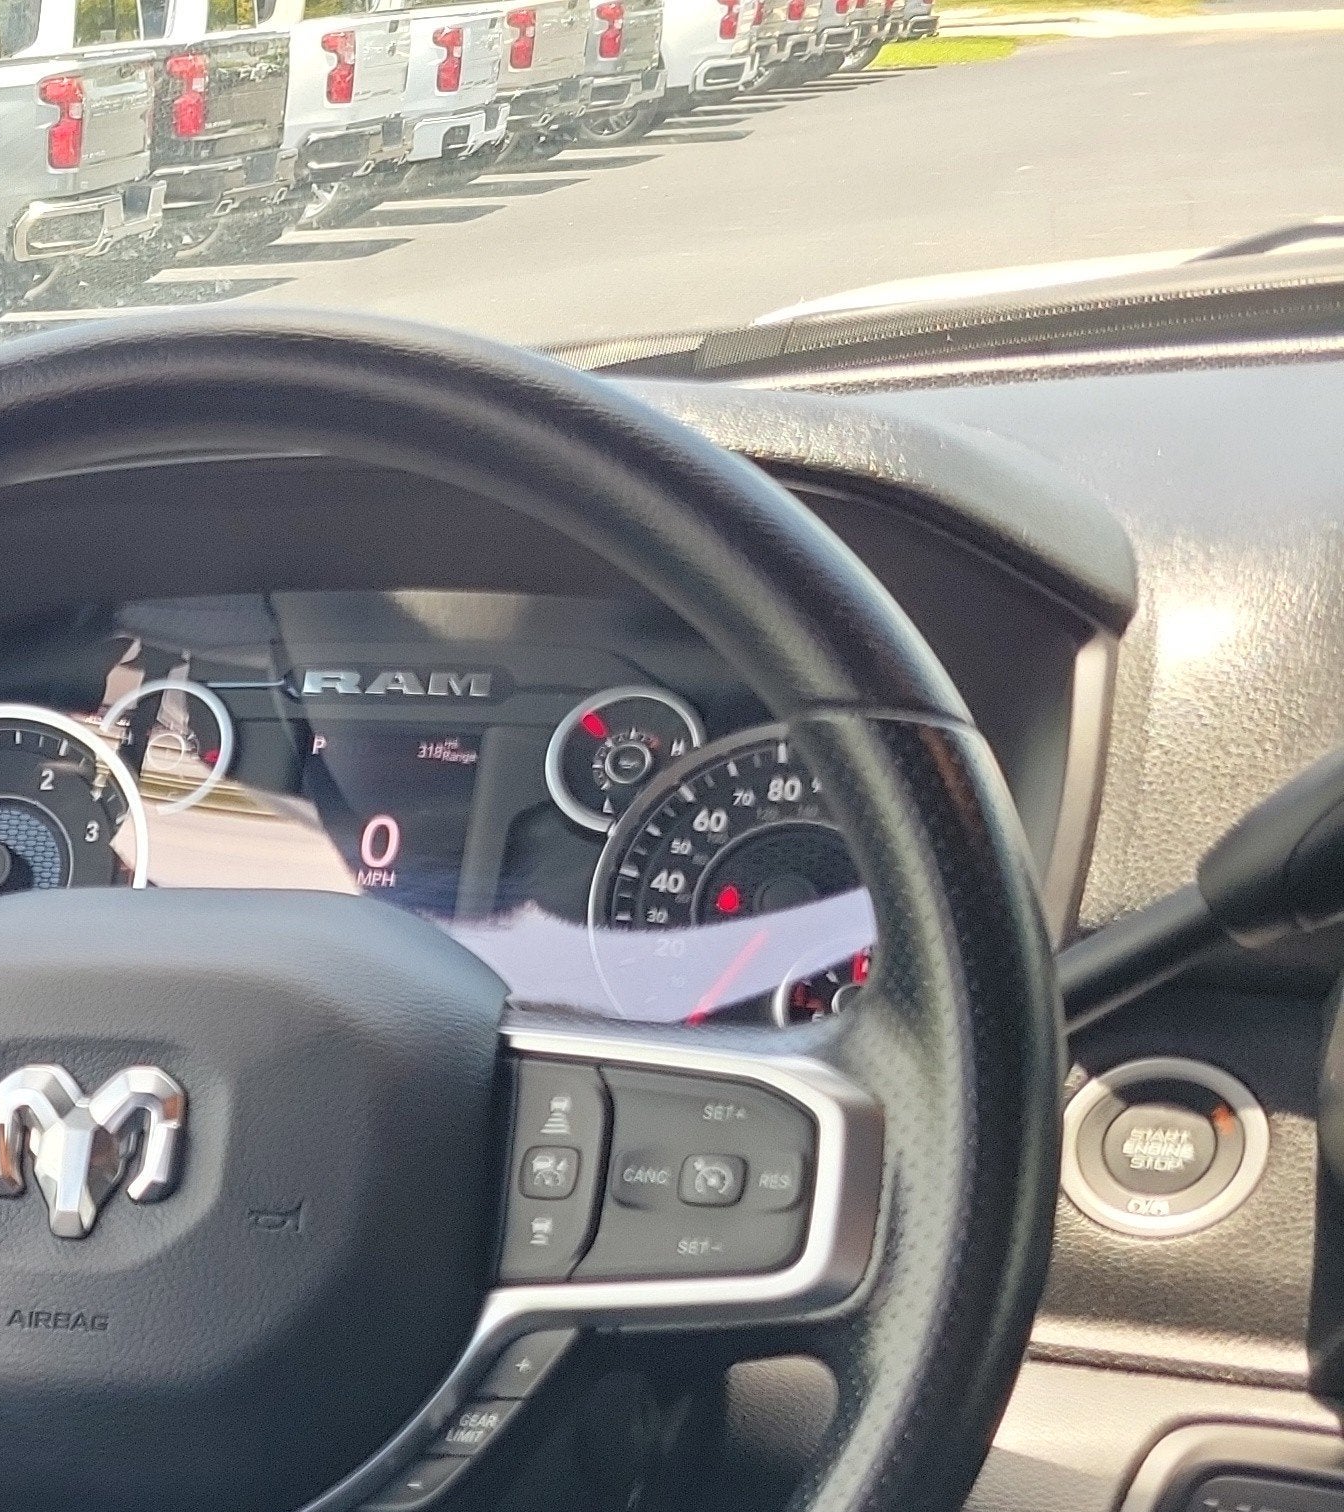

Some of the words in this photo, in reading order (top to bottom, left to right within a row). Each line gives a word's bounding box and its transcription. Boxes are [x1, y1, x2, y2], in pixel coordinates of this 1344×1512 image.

[301, 669, 492, 697] RAM
[312, 734, 327, 755] P
[442, 750, 478, 764] Range
[40, 769, 55, 793] 2
[767, 775, 804, 802] 80
[732, 788, 756, 807] 70
[692, 807, 728, 833] 60
[85, 821, 100, 843] 3
[362, 814, 401, 868] 0
[670, 838, 692, 855] 50
[357, 870, 395, 888] MPH
[649, 869, 685, 894] 40
[646, 907, 669, 924] 30
[622, 1168, 668, 1185] CANC
[758, 1173, 790, 1188] RES
[6, 1309, 109, 1333] AIRBAG
[459, 1412, 498, 1428] GEAR
[445, 1429, 484, 1443] LIMIT
